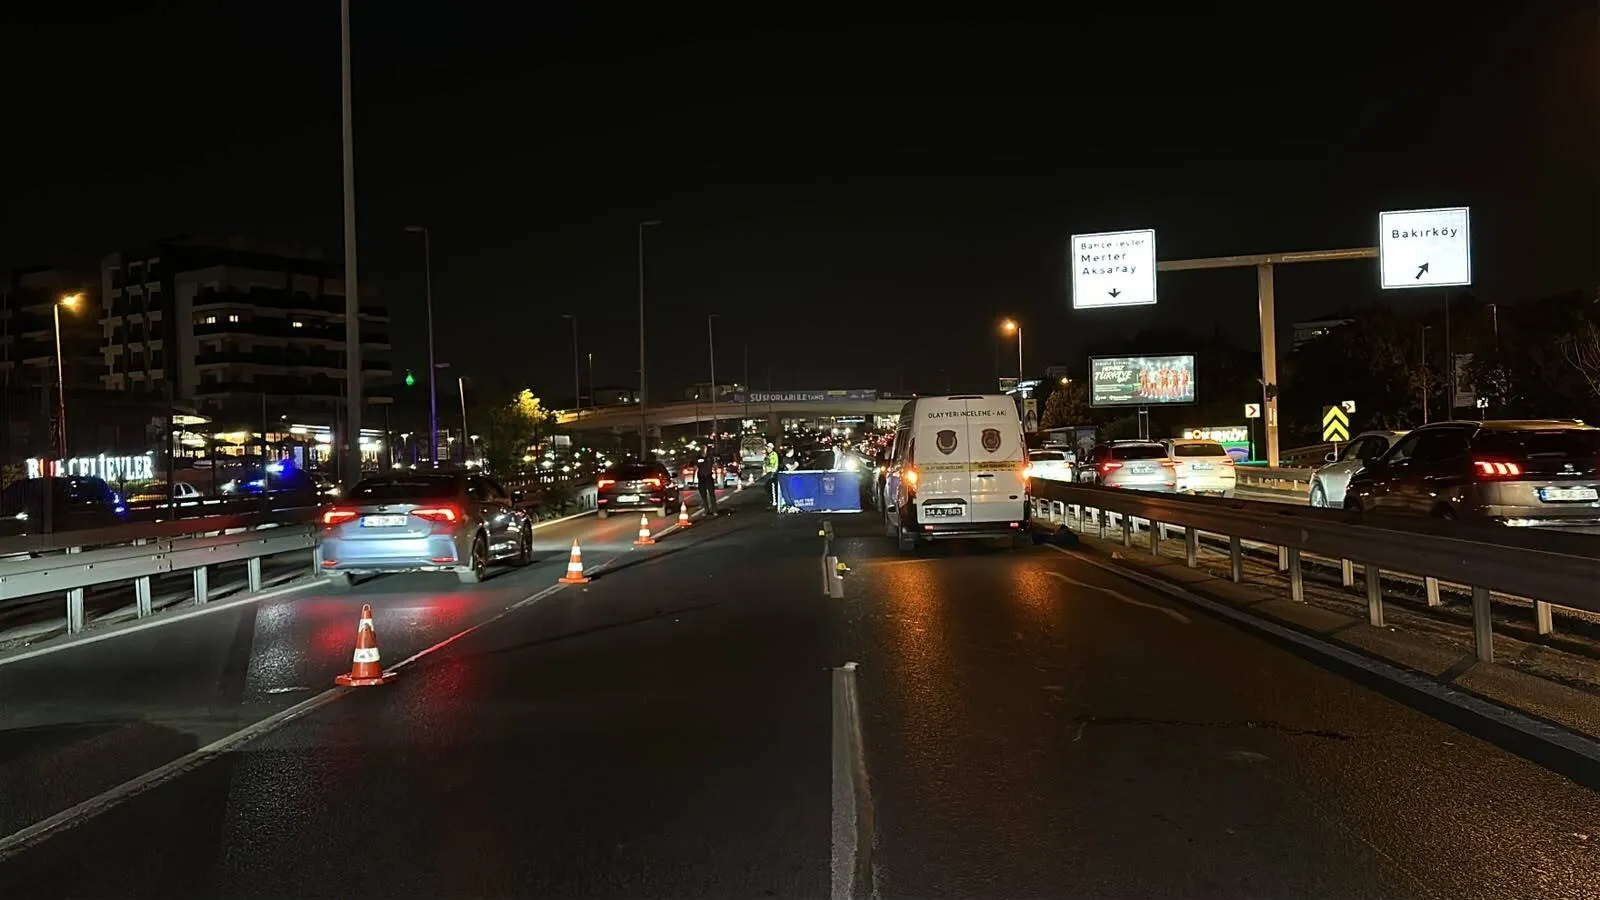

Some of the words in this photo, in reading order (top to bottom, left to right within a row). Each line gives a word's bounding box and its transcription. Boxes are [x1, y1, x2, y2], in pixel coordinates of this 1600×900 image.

[1391, 226, 1458, 239] Bakırköy
[1081, 253, 1127, 263] Merter
[1082, 266, 1137, 276] Aksaray
